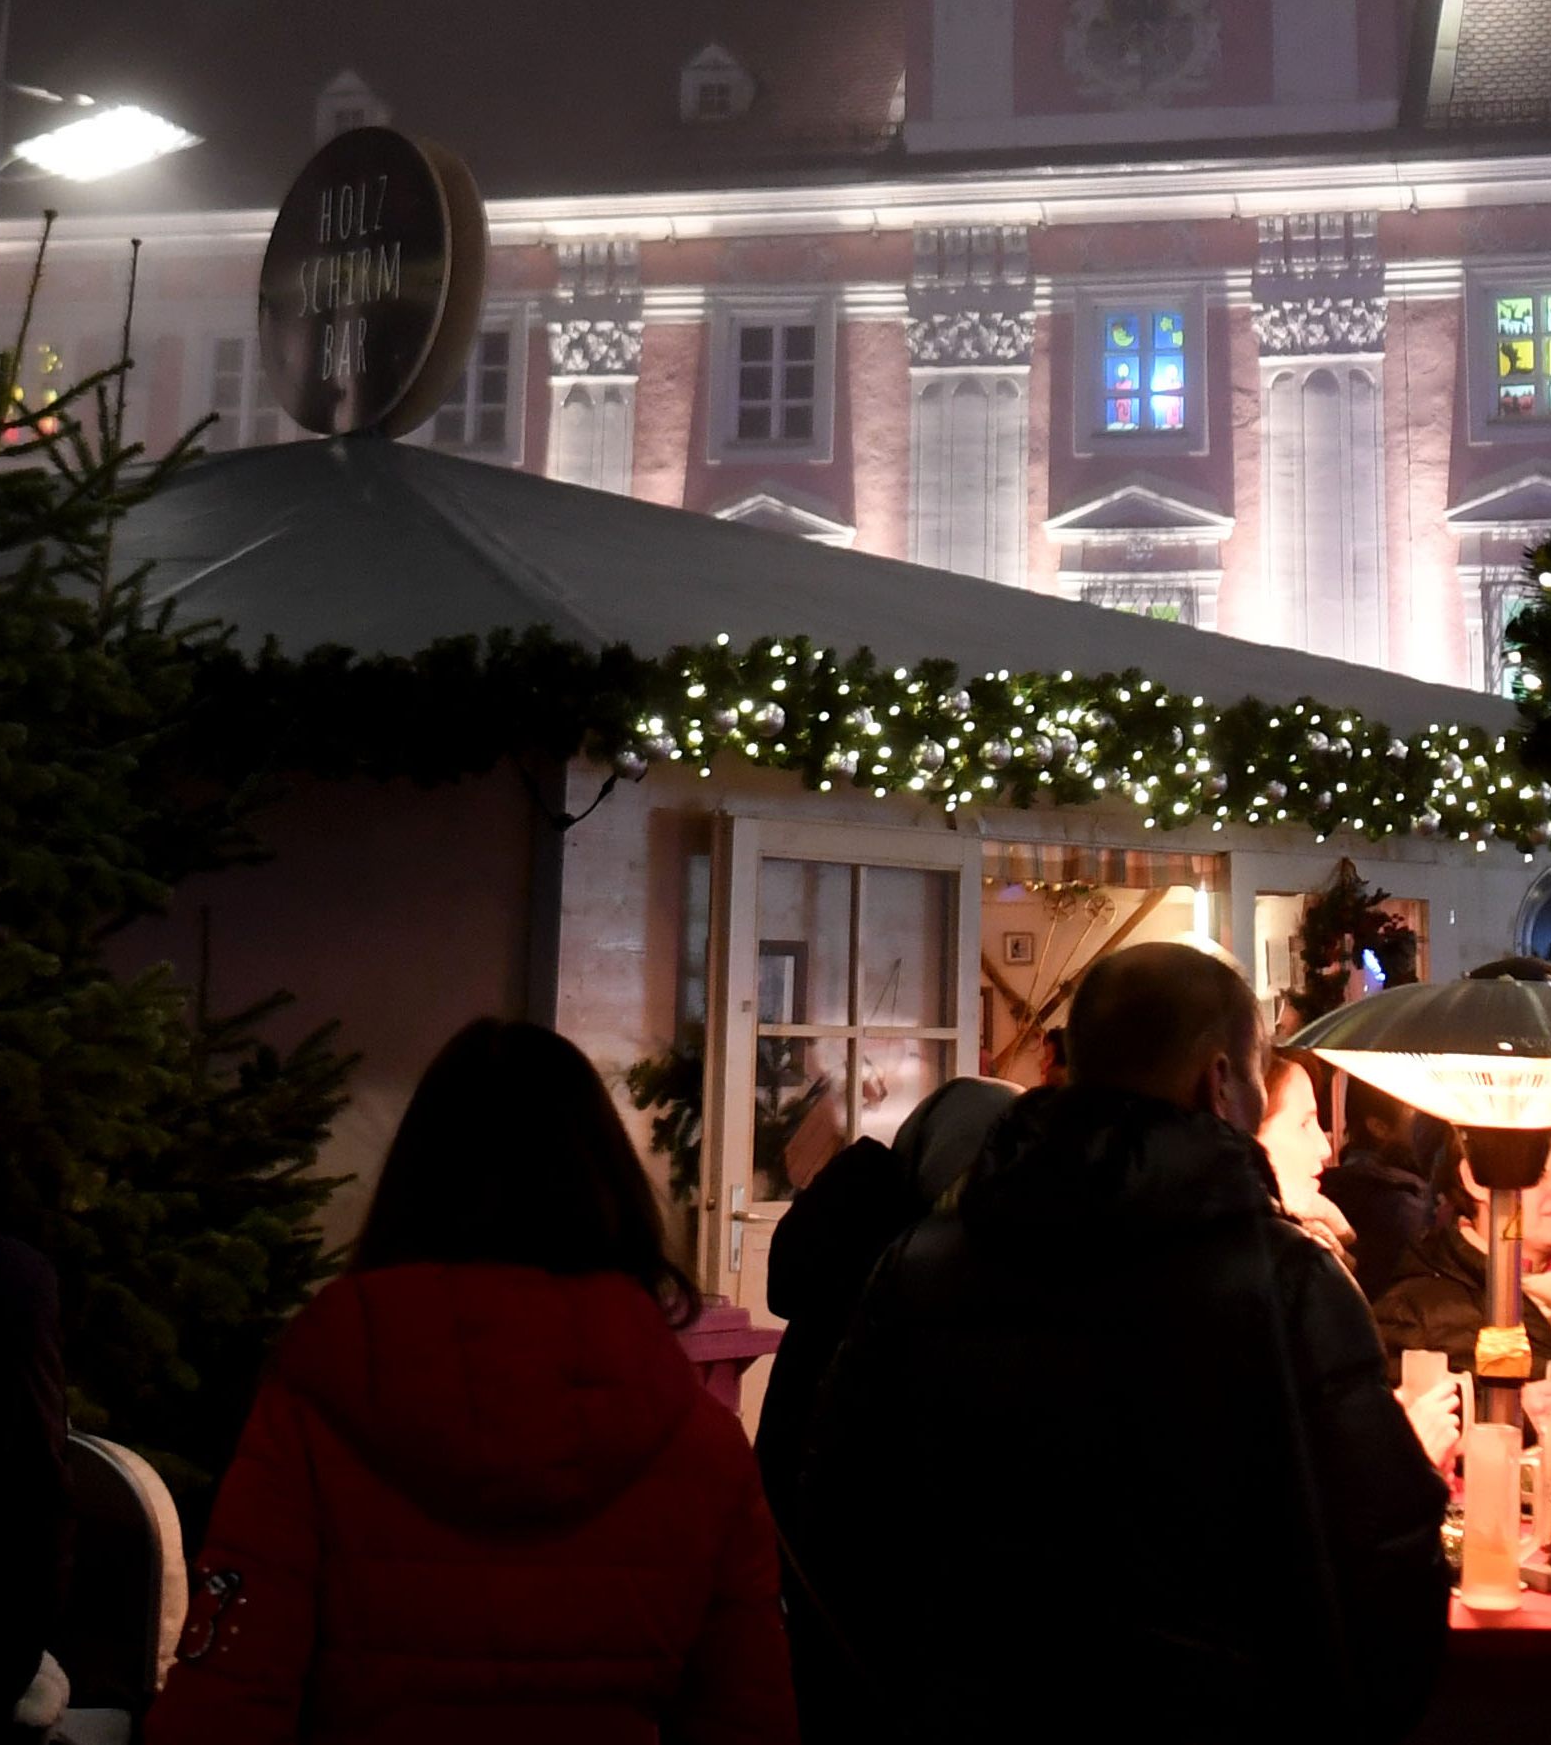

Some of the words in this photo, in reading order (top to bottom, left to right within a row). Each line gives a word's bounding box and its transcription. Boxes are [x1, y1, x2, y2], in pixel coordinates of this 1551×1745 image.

[319, 174, 388, 243] HOLZ
[297, 241, 402, 318] SCHIRM
[322, 317, 368, 382] BAR
